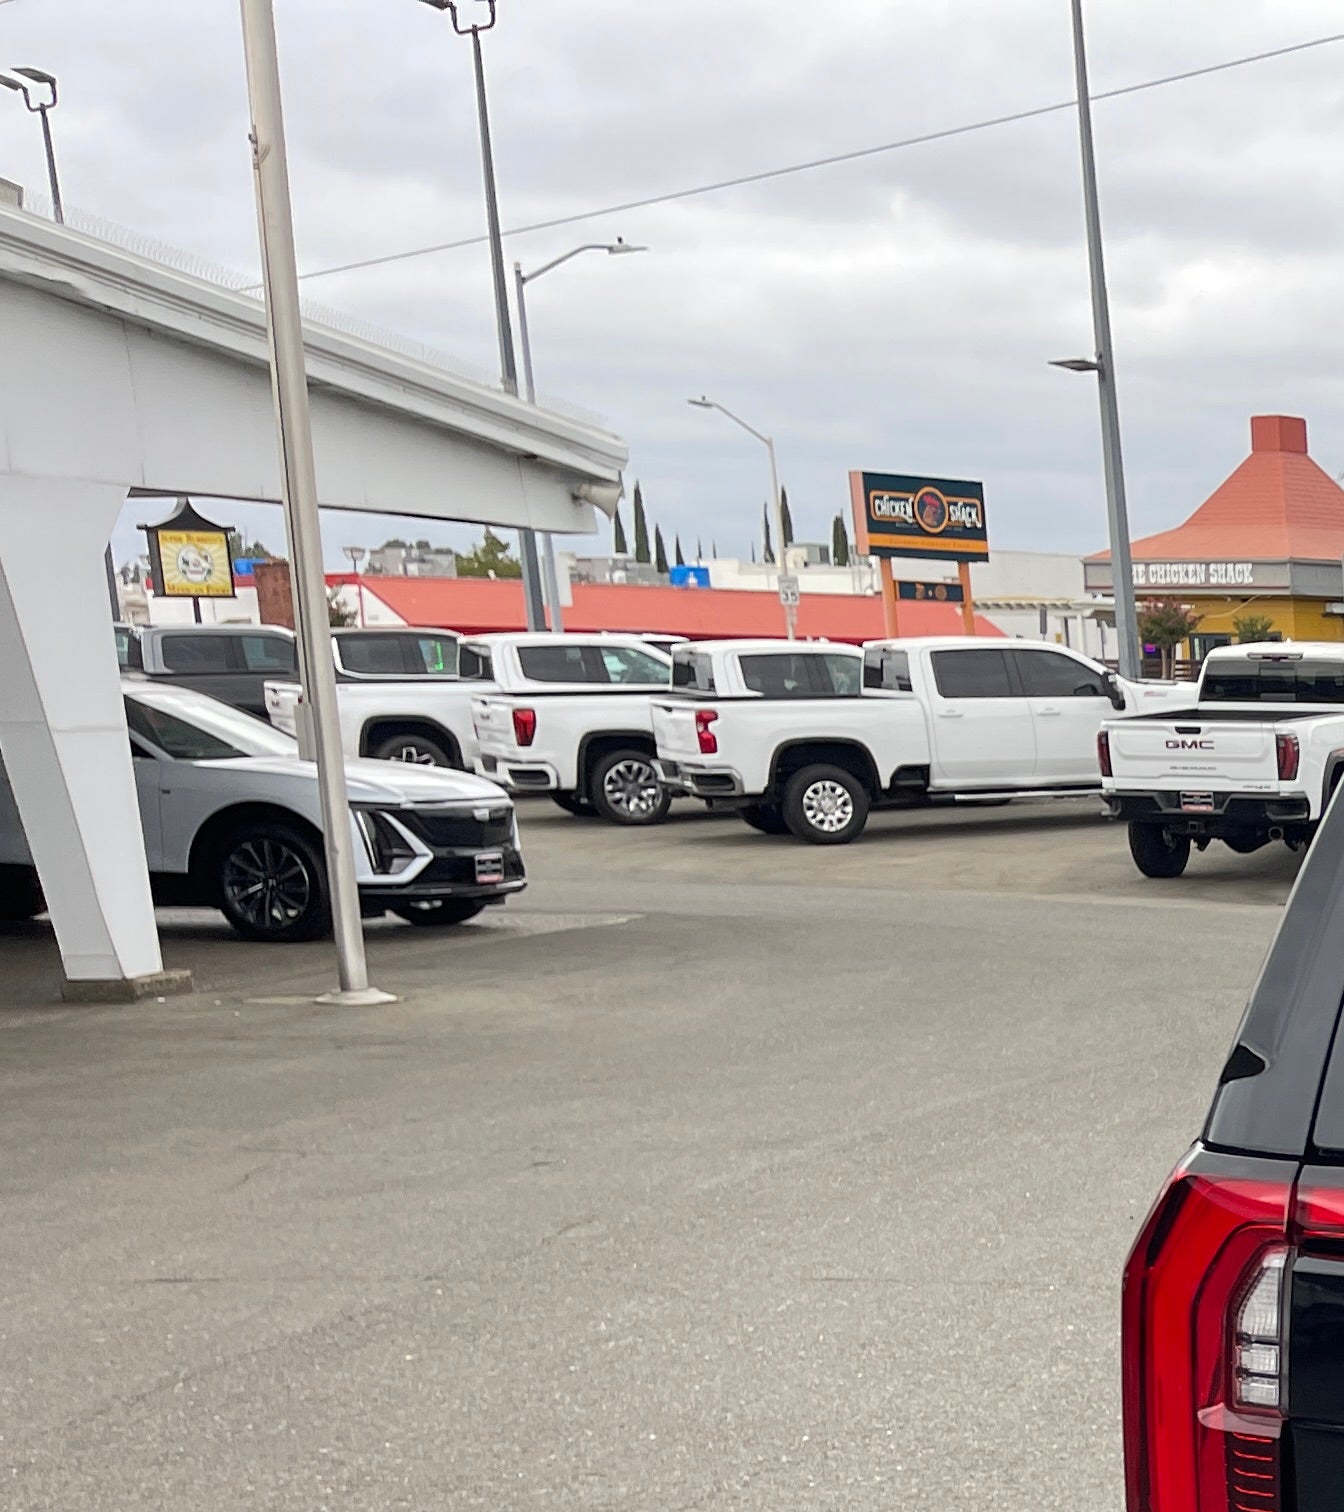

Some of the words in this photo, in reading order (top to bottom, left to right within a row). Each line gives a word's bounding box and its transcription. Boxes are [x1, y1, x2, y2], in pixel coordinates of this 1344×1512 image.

[874, 494, 915, 524] CHICKEN
[949, 501, 983, 528] SHACK
[1149, 563, 1206, 584] CHICKEN
[1209, 563, 1254, 584] SHACK
[1165, 740, 1215, 750] GMC
